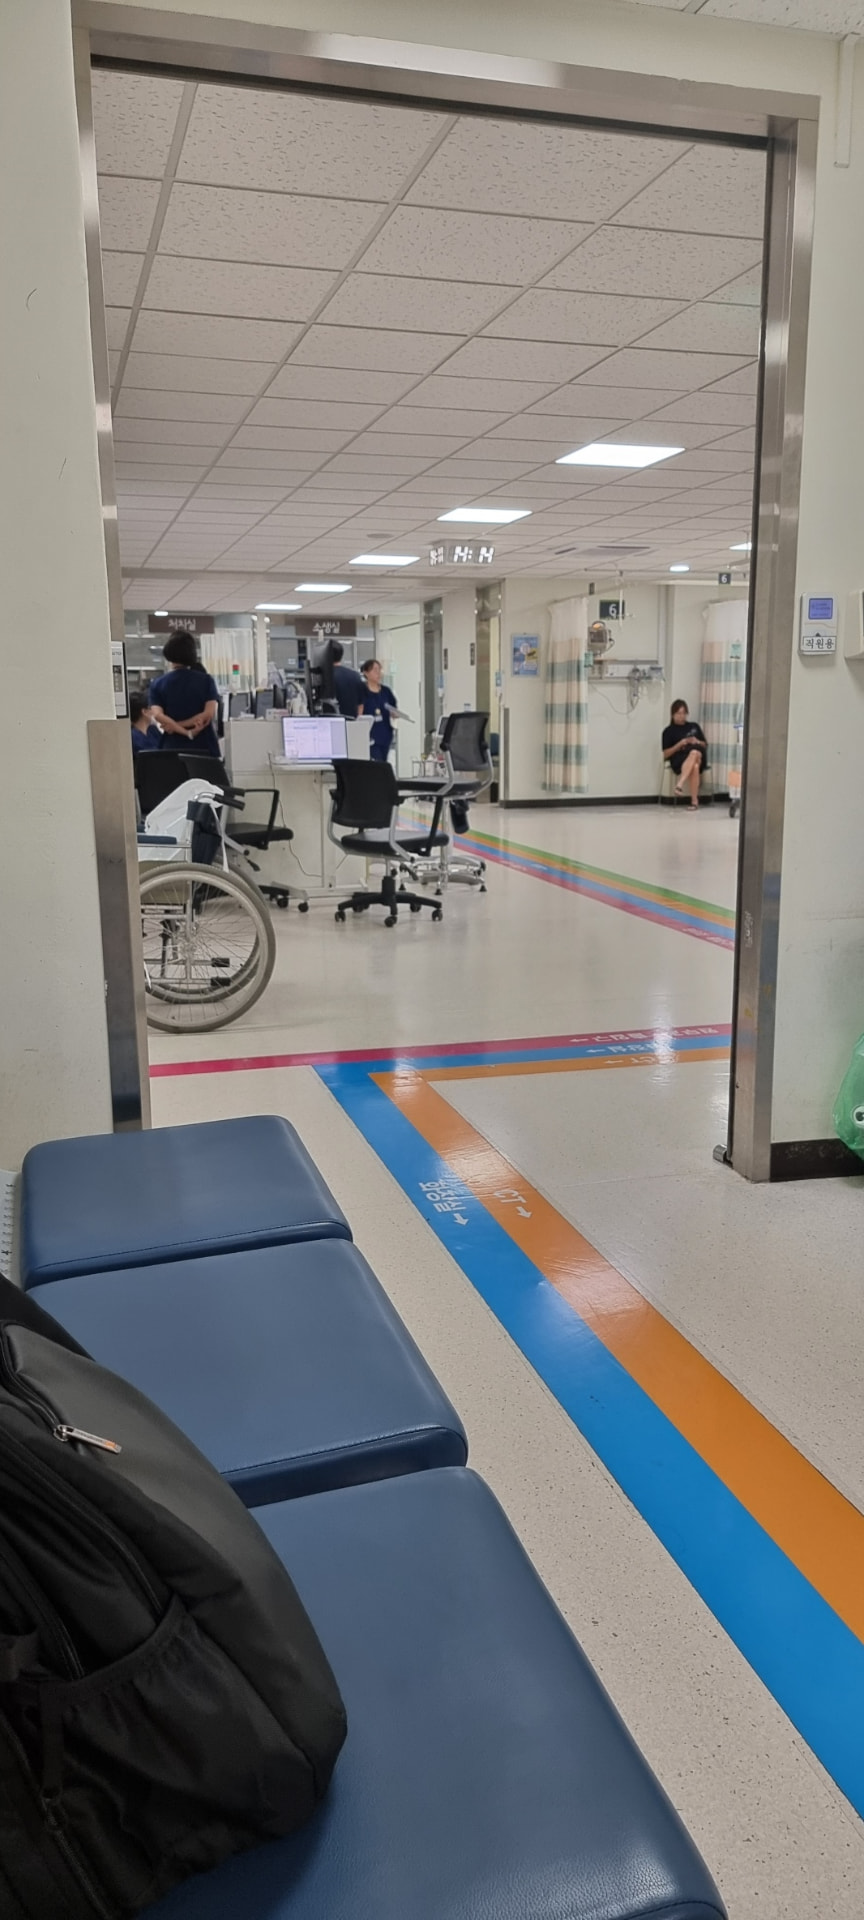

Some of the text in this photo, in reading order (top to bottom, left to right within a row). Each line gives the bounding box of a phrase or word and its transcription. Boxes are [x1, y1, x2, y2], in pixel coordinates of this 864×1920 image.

[721, 574, 728, 584] 6
[608, 603, 617, 617] 6
[168, 617, 197, 631] 처치실
[312, 621, 341, 634] 소생실
[805, 637, 834, 649] 직원용
[419, 1178, 467, 1212] 화장실
[494, 1188, 526, 1204] CT
